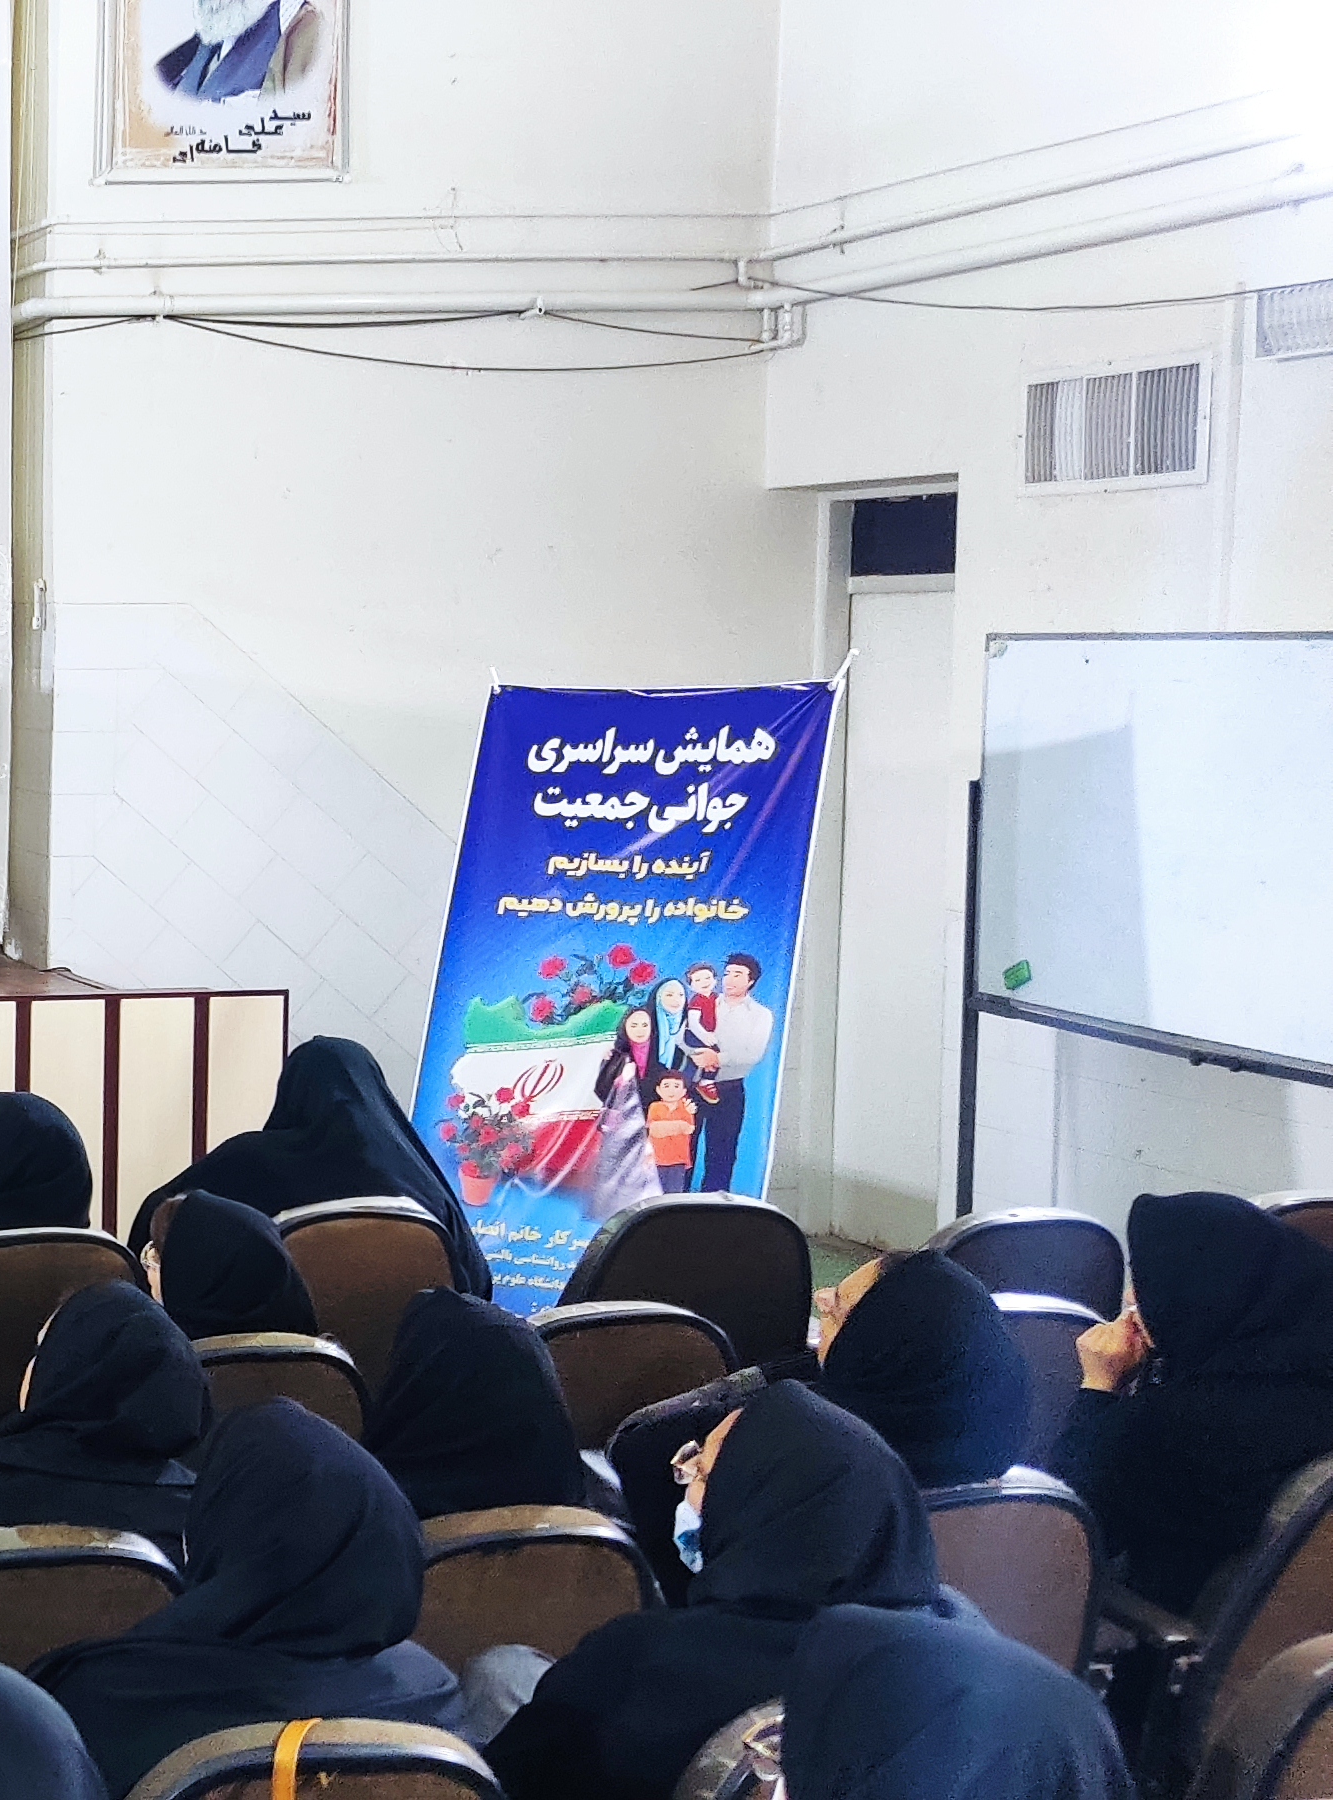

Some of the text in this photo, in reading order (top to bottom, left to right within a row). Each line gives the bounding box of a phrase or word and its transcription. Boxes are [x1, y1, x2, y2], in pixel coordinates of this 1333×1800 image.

[238, 117, 284, 137] علی
[268, 108, 312, 127] سید
[526, 724, 777, 776] همایش سراسری
[532, 781, 750, 834] جوانی جمعیت
[546, 850, 713, 881] آینده را بسازیم
[496, 892, 751, 925] خانواده را پرورش دهیم
[508, 1225, 543, 1243] خانم
